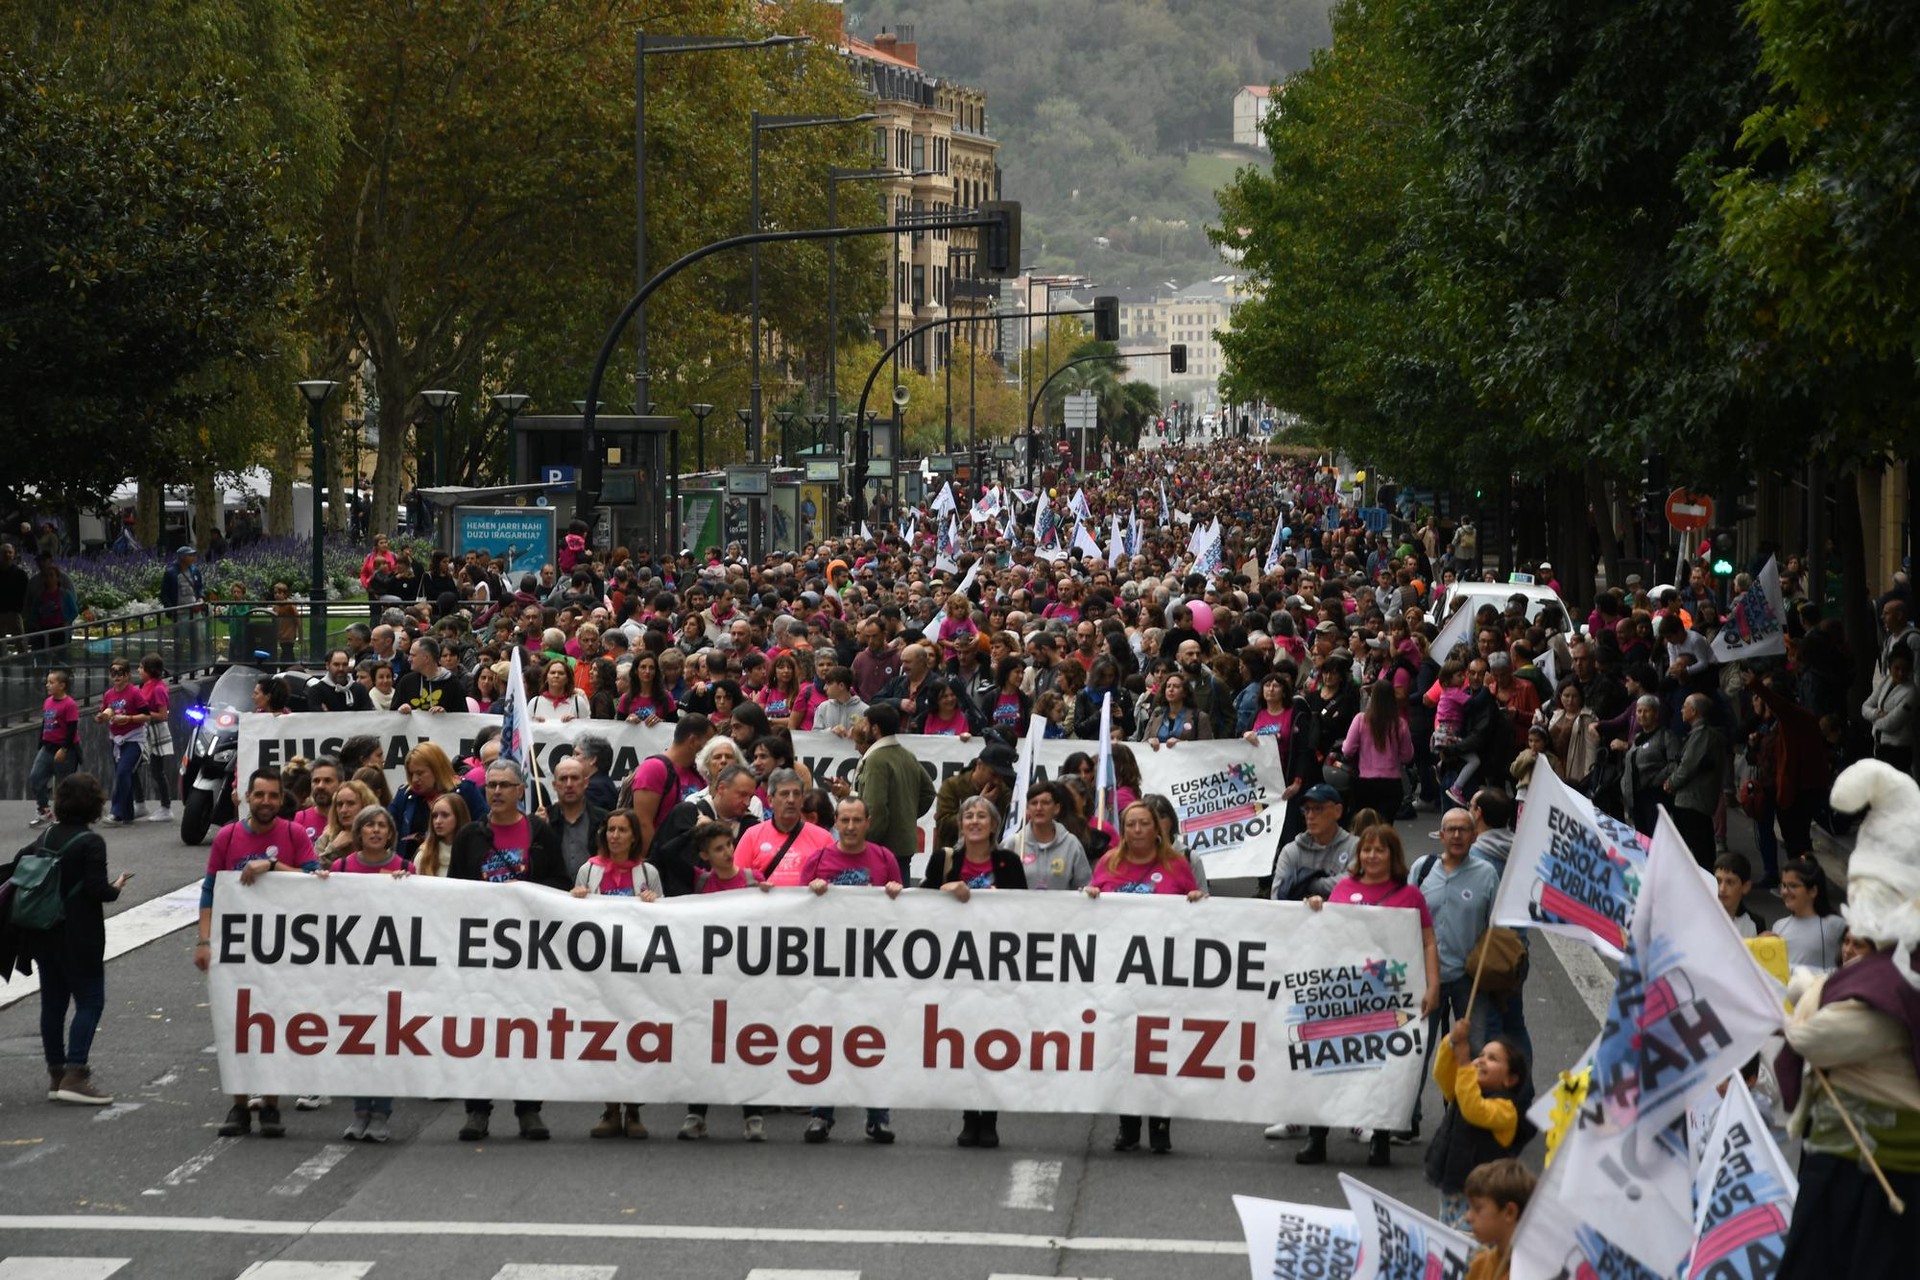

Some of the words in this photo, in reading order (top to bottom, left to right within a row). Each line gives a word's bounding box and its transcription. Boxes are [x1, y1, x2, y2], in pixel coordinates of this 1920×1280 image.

[549, 469, 562, 483] P
[466, 522, 497, 530] HEMEN
[497, 522, 520, 531] JARRI
[521, 522, 542, 531] NAHI
[466, 531, 490, 539] DUZU
[491, 531, 540, 540] IRAGARKIA?
[1171, 771, 1229, 796] EUSKAL
[1179, 782, 1239, 807] ESKOLA
[1187, 787, 1267, 817] PUBLIKOAZ
[1550, 834, 1613, 890] ESKOLA
[219, 913, 438, 967] EUSKAL
[458, 917, 683, 976] ESKOLA
[702, 925, 1097, 984] PUBLIKOAREN
[1116, 936, 1281, 1001] ALDE,
[1284, 965, 1362, 989] EUSKAL
[1294, 981, 1373, 1004] ESKOLA
[1305, 993, 1414, 1021] PUBLIKOAZ
[236, 988, 673, 1064] hezkuntza
[711, 999, 888, 1085] lege
[923, 1005, 1096, 1074] honi
[1134, 1016, 1256, 1083] EZ!
[1288, 1028, 1422, 1071] HARRO!
